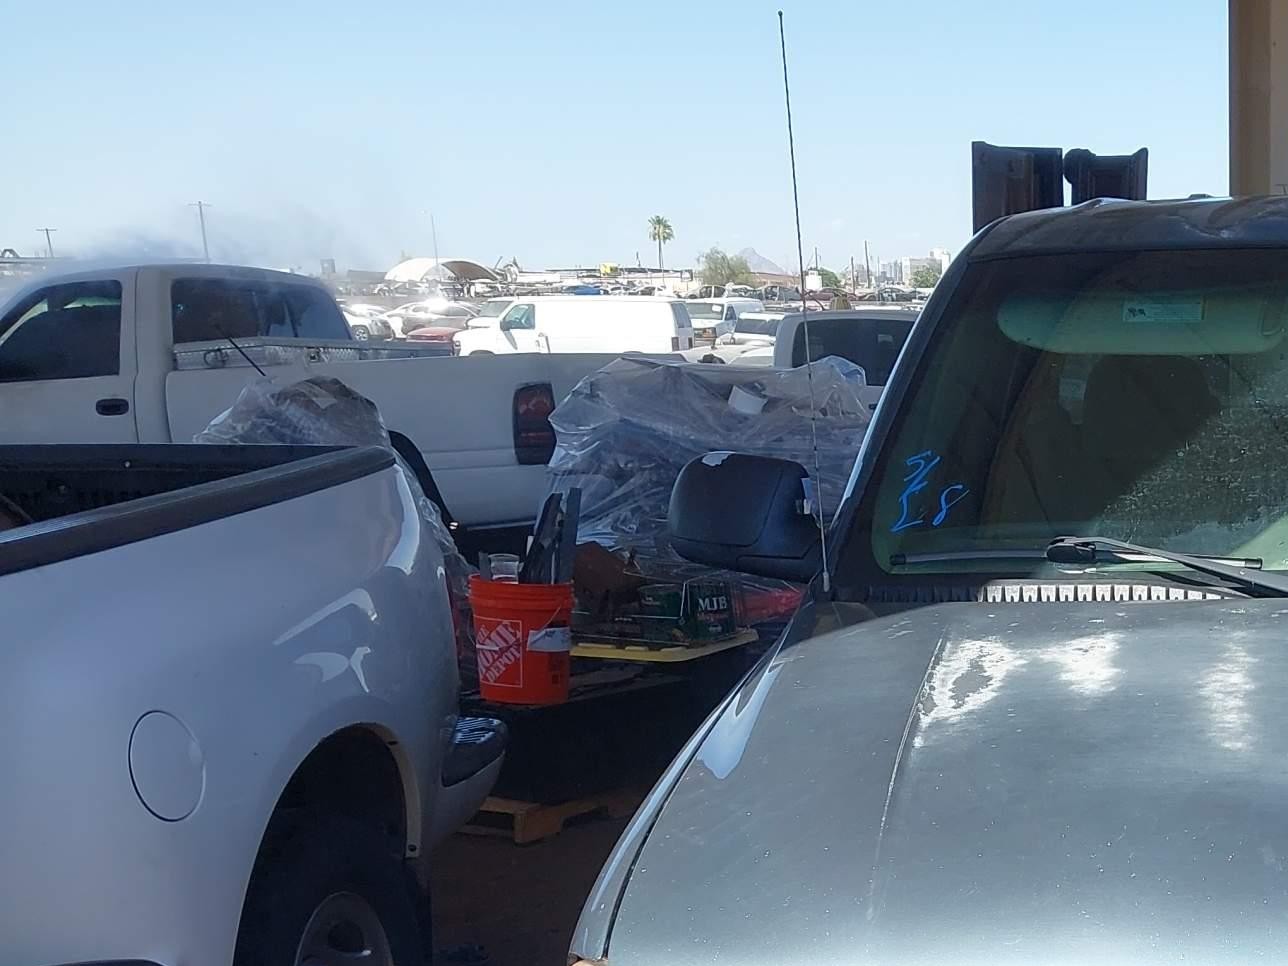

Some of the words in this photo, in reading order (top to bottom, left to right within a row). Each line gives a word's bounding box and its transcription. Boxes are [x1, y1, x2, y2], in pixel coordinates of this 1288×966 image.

[698, 595, 728, 612] MJB
[477, 620, 521, 680] HOME
[485, 643, 521, 683] DEPOT
